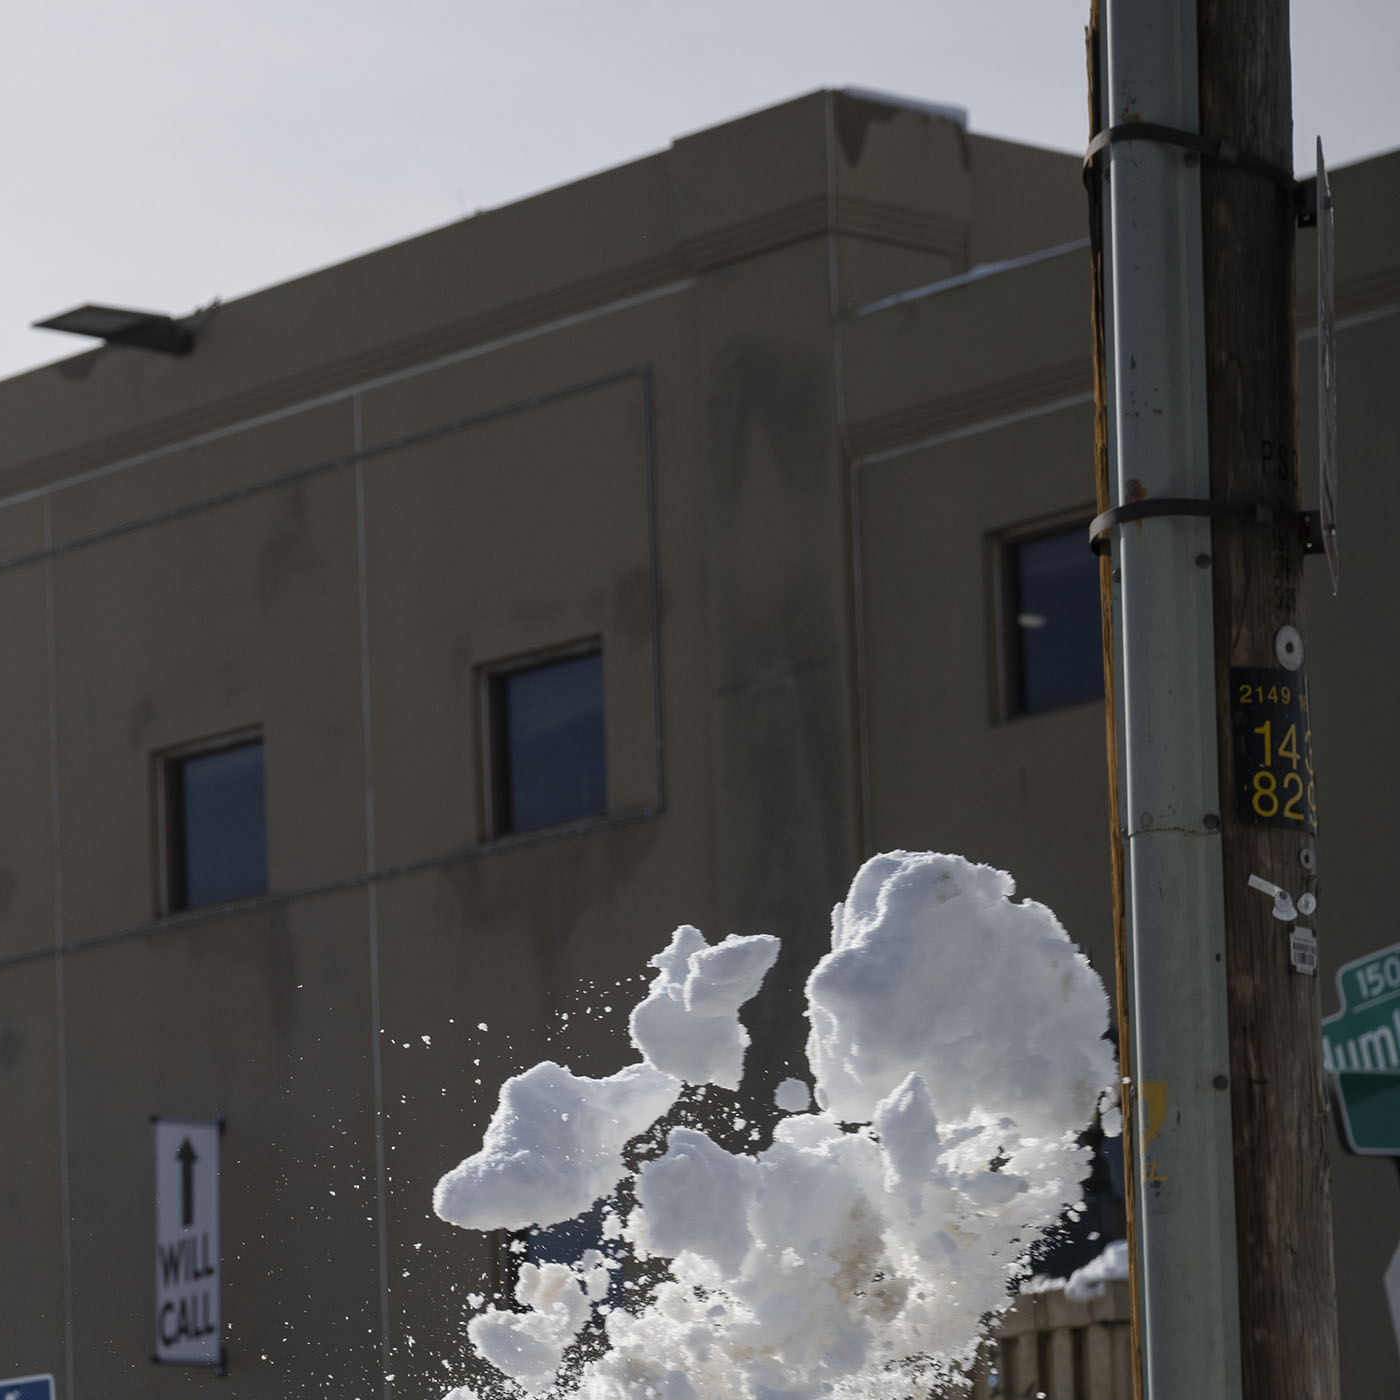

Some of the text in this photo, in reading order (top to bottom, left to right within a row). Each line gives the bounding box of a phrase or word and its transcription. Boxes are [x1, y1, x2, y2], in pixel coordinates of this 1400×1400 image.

[1239, 684, 1291, 705] 2149
[158, 1230, 215, 1289] WILL
[158, 1293, 215, 1348] CALL
